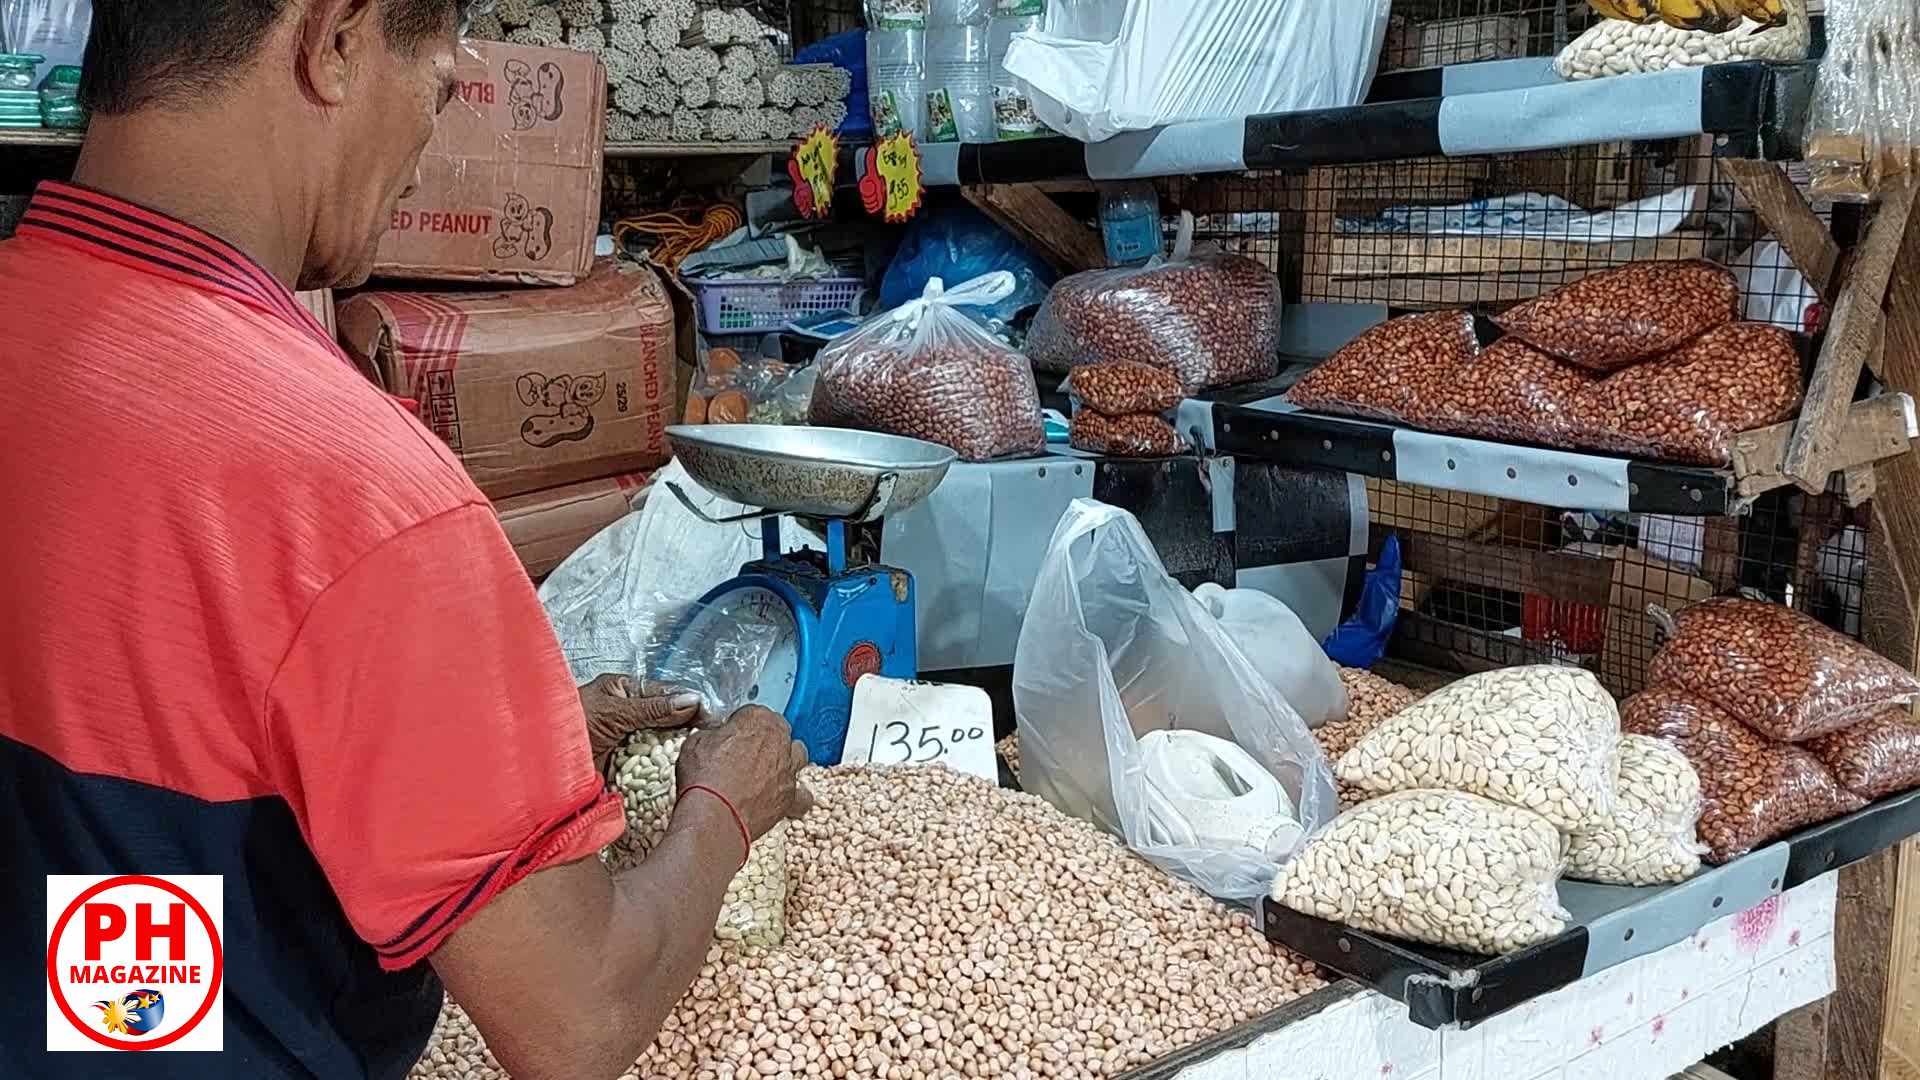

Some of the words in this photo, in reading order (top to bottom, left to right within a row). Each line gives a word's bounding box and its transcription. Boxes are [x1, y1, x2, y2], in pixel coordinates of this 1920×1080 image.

[419, 211, 492, 235] PEANUT
[639, 322, 659, 401] BLANCHED
[615, 382, 629, 413] 25/29
[646, 403, 663, 457] PEANUT
[867, 720, 984, 762] 135.00
